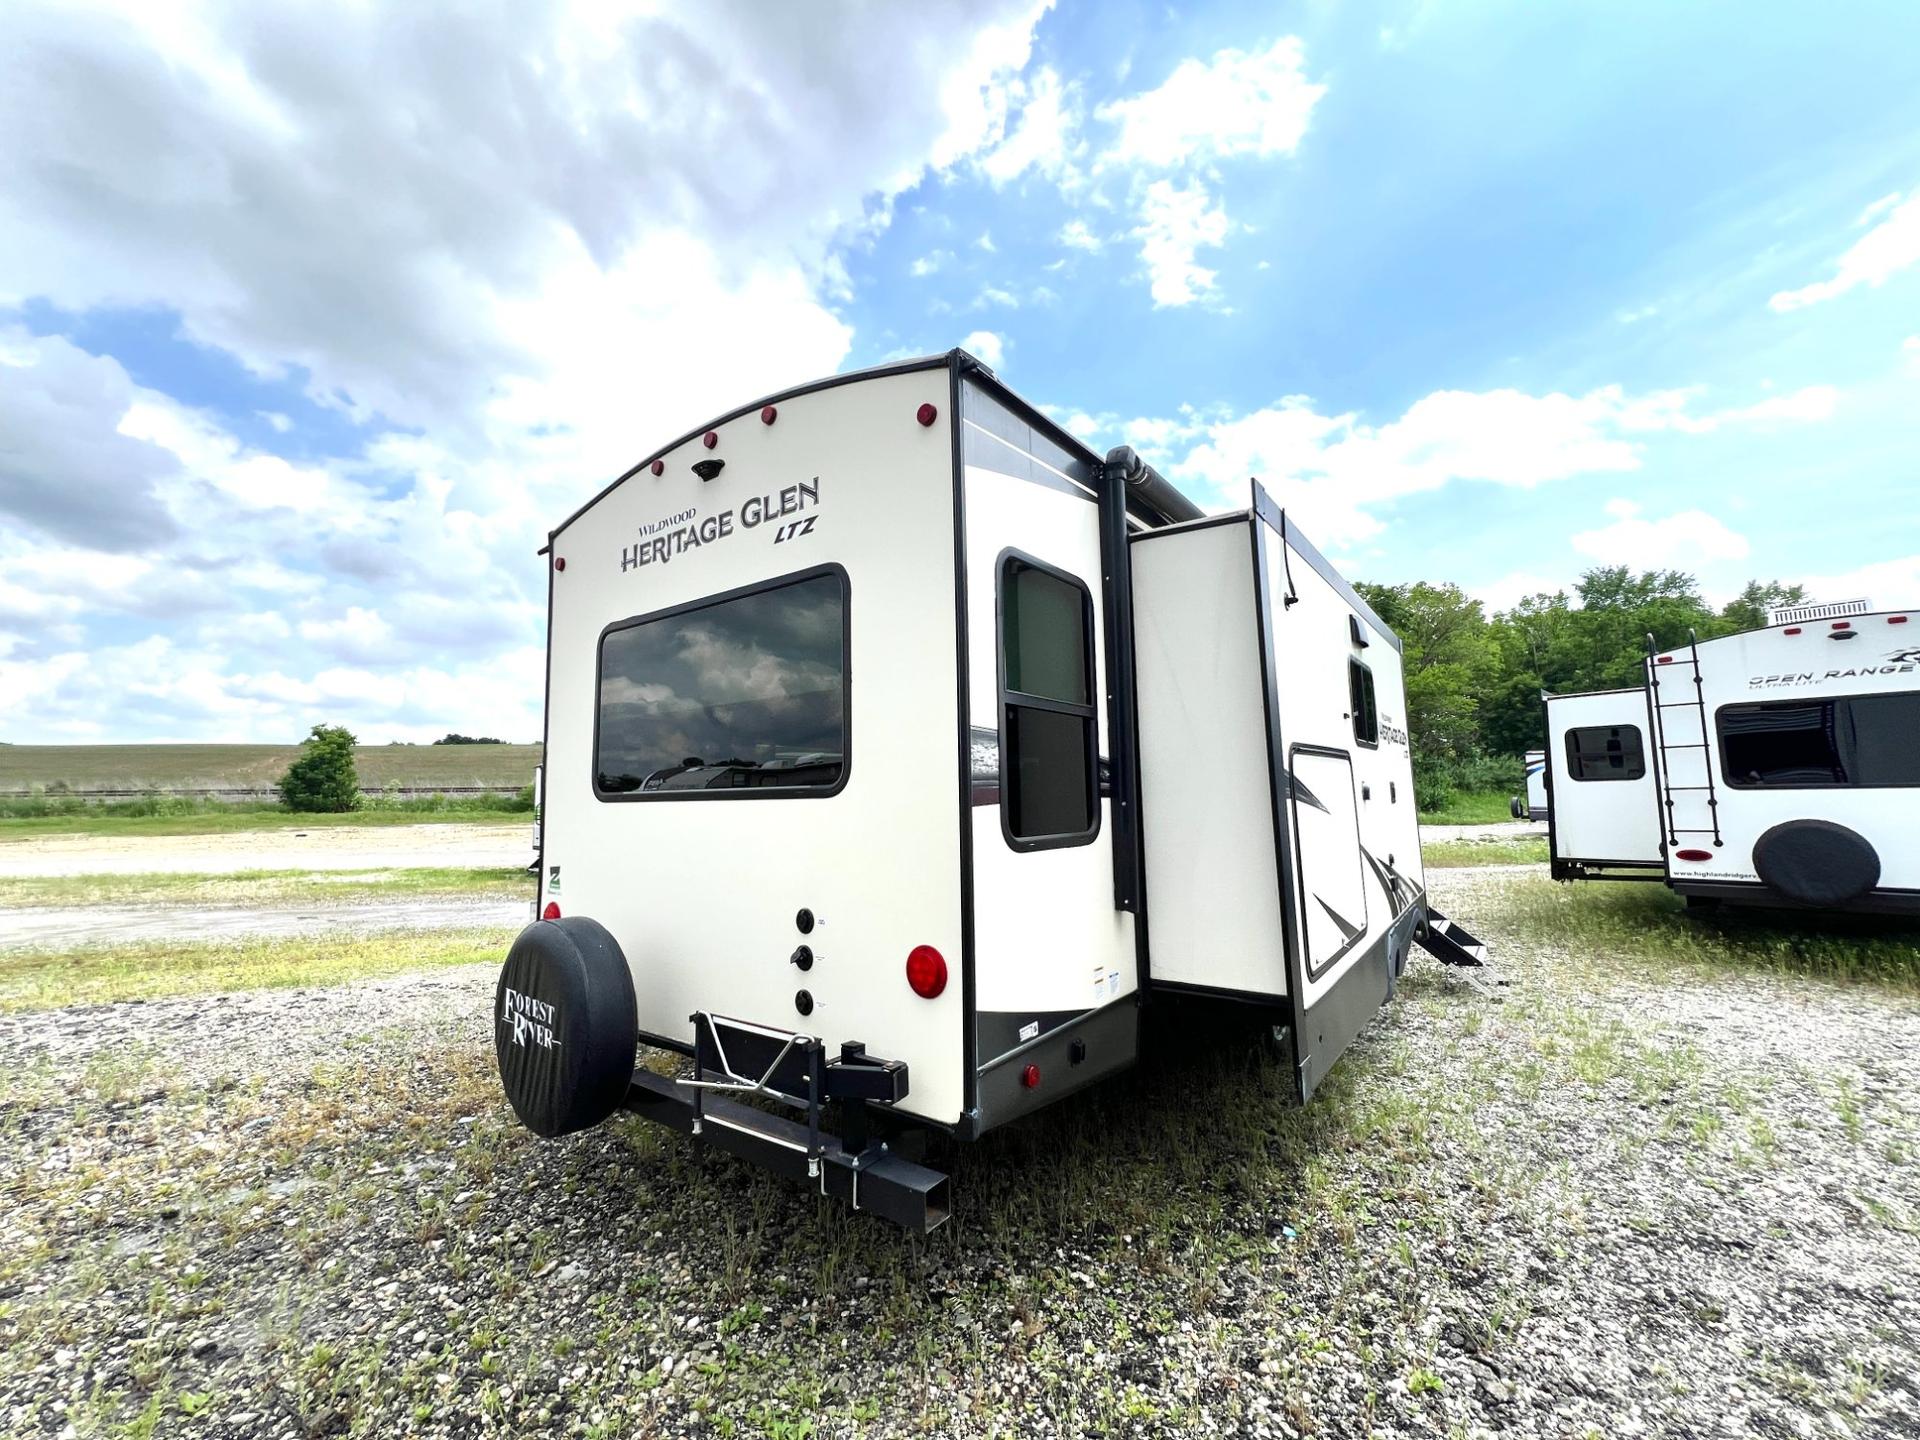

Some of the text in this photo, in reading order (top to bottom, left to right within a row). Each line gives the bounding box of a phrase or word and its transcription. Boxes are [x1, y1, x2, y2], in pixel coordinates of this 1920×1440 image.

[621, 476, 819, 573] HERITAGE GLEN
[638, 508, 697, 537] WILDWOOD
[774, 515, 819, 544] LTZ
[1749, 664, 1916, 685] OPEN RANGE
[504, 988, 555, 1025] FOREST
